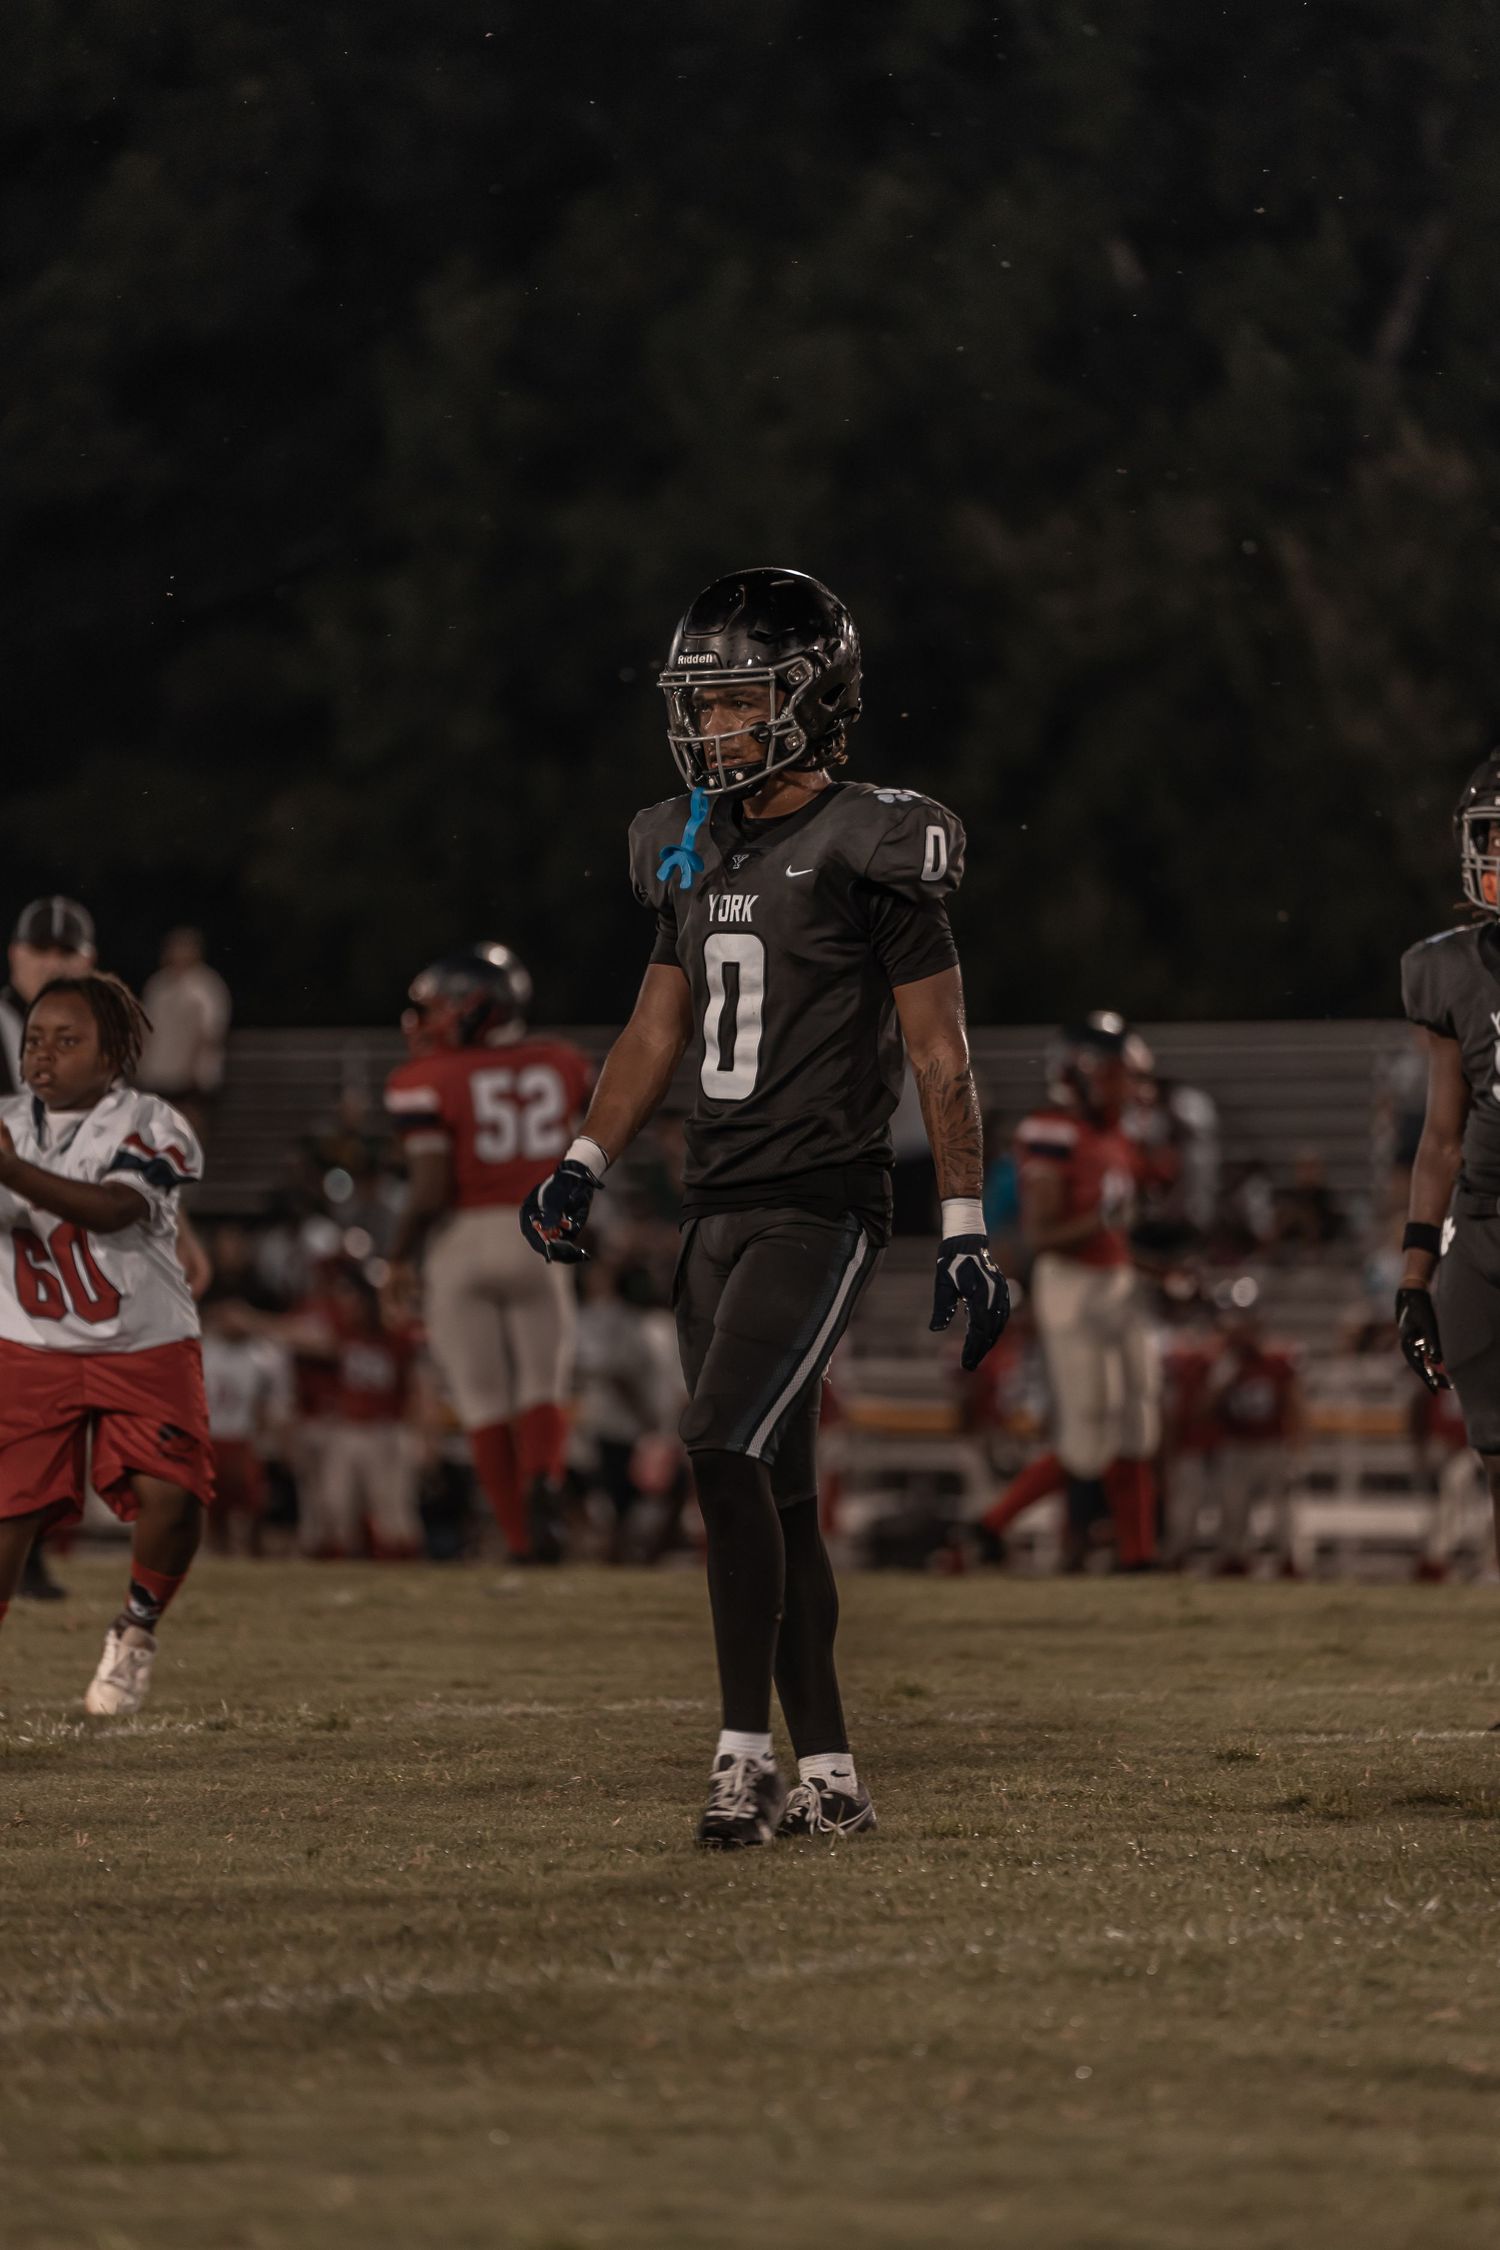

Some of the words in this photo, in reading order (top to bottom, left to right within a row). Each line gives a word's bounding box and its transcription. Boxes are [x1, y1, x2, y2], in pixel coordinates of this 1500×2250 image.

[677, 653, 713, 665] Riddell
[920, 825, 948, 881] 0
[708, 893, 759, 923] YORK
[700, 933, 765, 1100] 0
[469, 1062, 567, 1164] 52
[11, 1220, 122, 1325] 60
